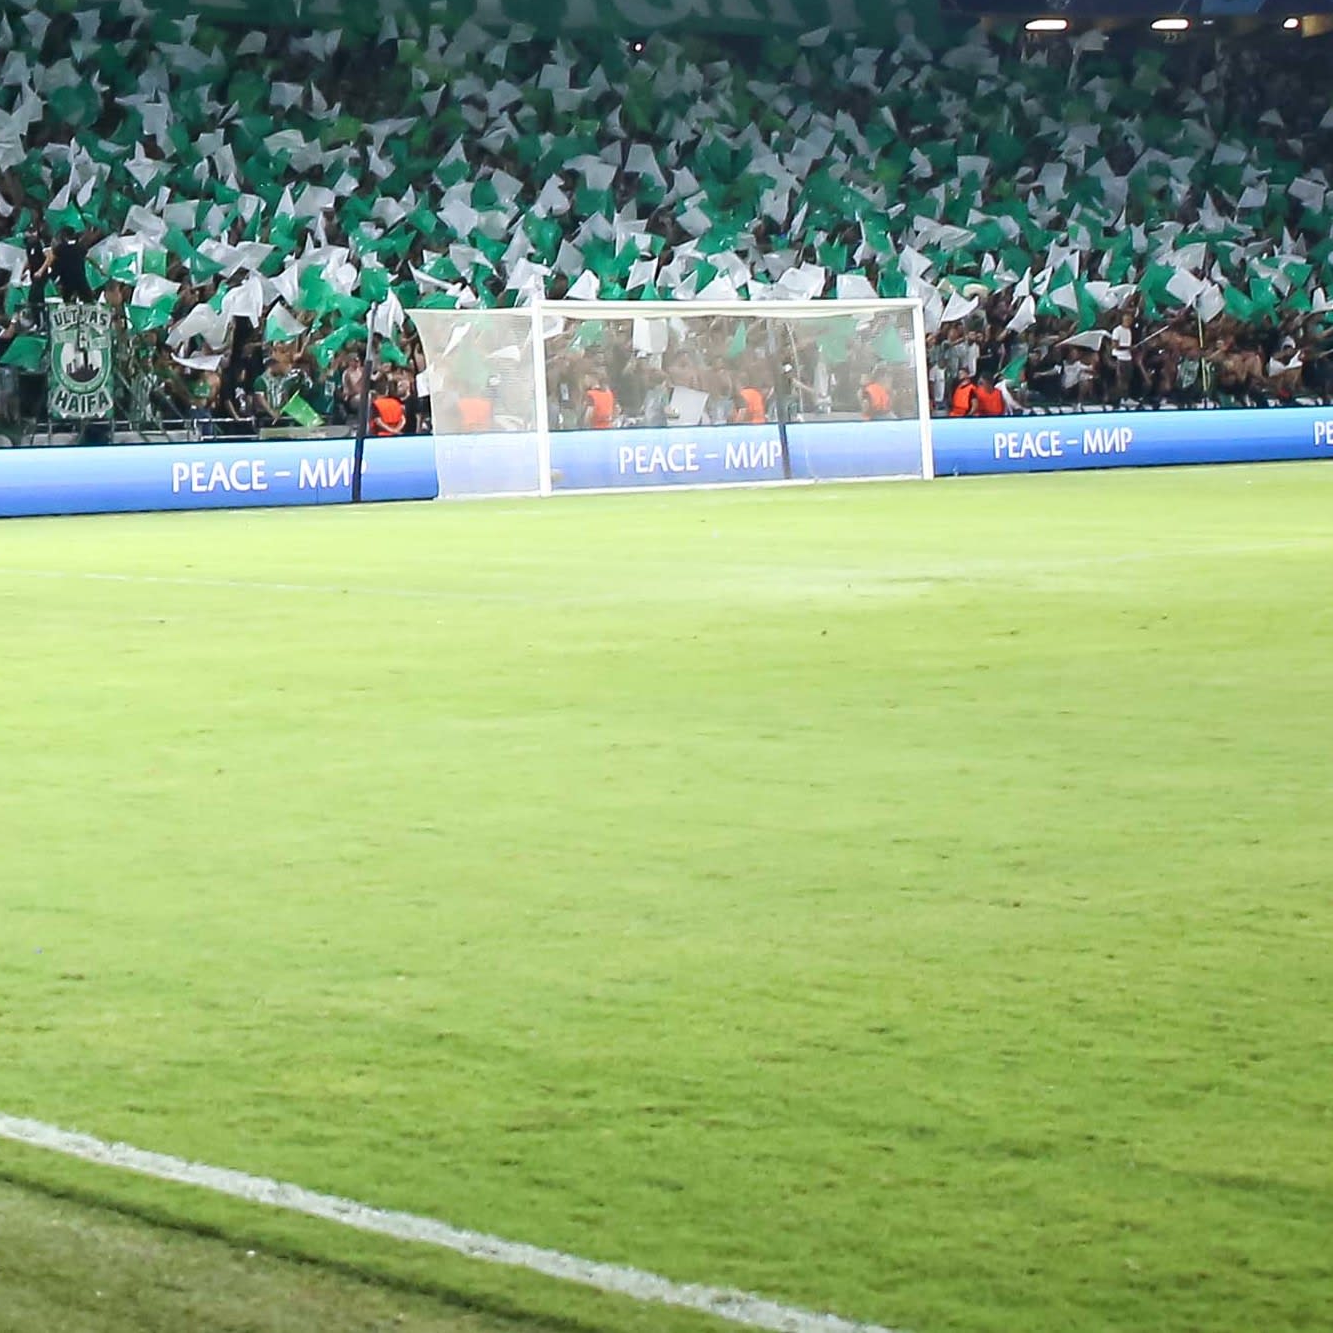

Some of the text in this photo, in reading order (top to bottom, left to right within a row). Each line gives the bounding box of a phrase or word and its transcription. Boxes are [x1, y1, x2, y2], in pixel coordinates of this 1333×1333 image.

[54, 389, 110, 414] HAIFA
[619, 442, 700, 474] PEACE
[725, 440, 783, 470] МИР
[994, 430, 1063, 459] PEACE
[1083, 427, 1133, 454] МИР
[172, 460, 268, 493] PEACE
